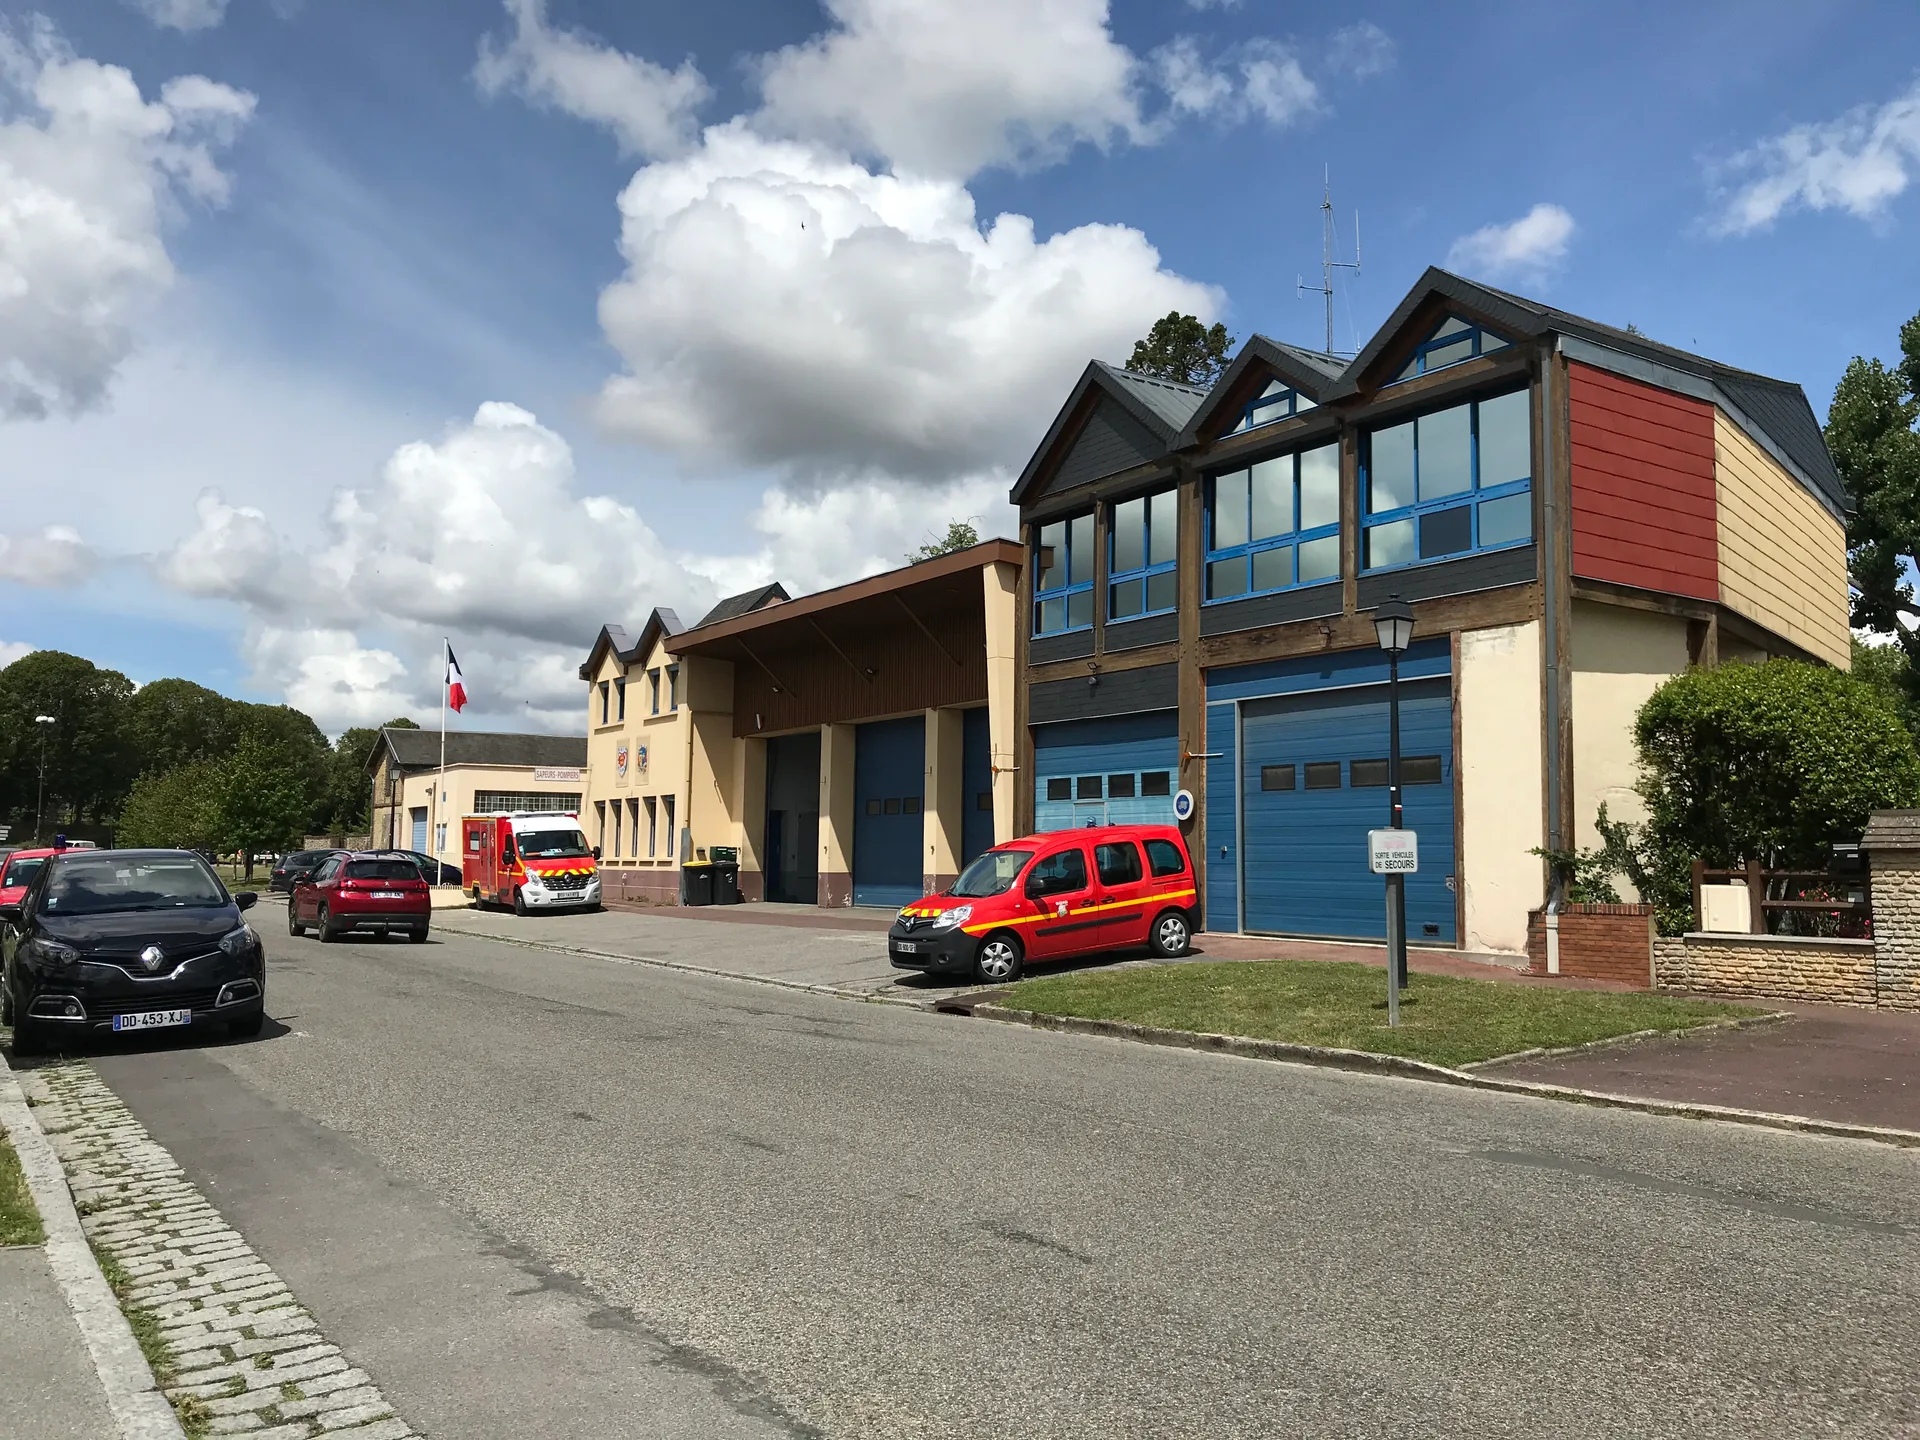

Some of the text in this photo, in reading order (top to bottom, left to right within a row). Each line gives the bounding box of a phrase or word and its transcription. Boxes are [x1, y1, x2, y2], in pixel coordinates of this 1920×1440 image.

[536, 771, 579, 779] SAPEURS-POMPIERS
[1385, 860, 1414, 869] SECOURS
[122, 1010, 182, 1027] DD-453-XJ
